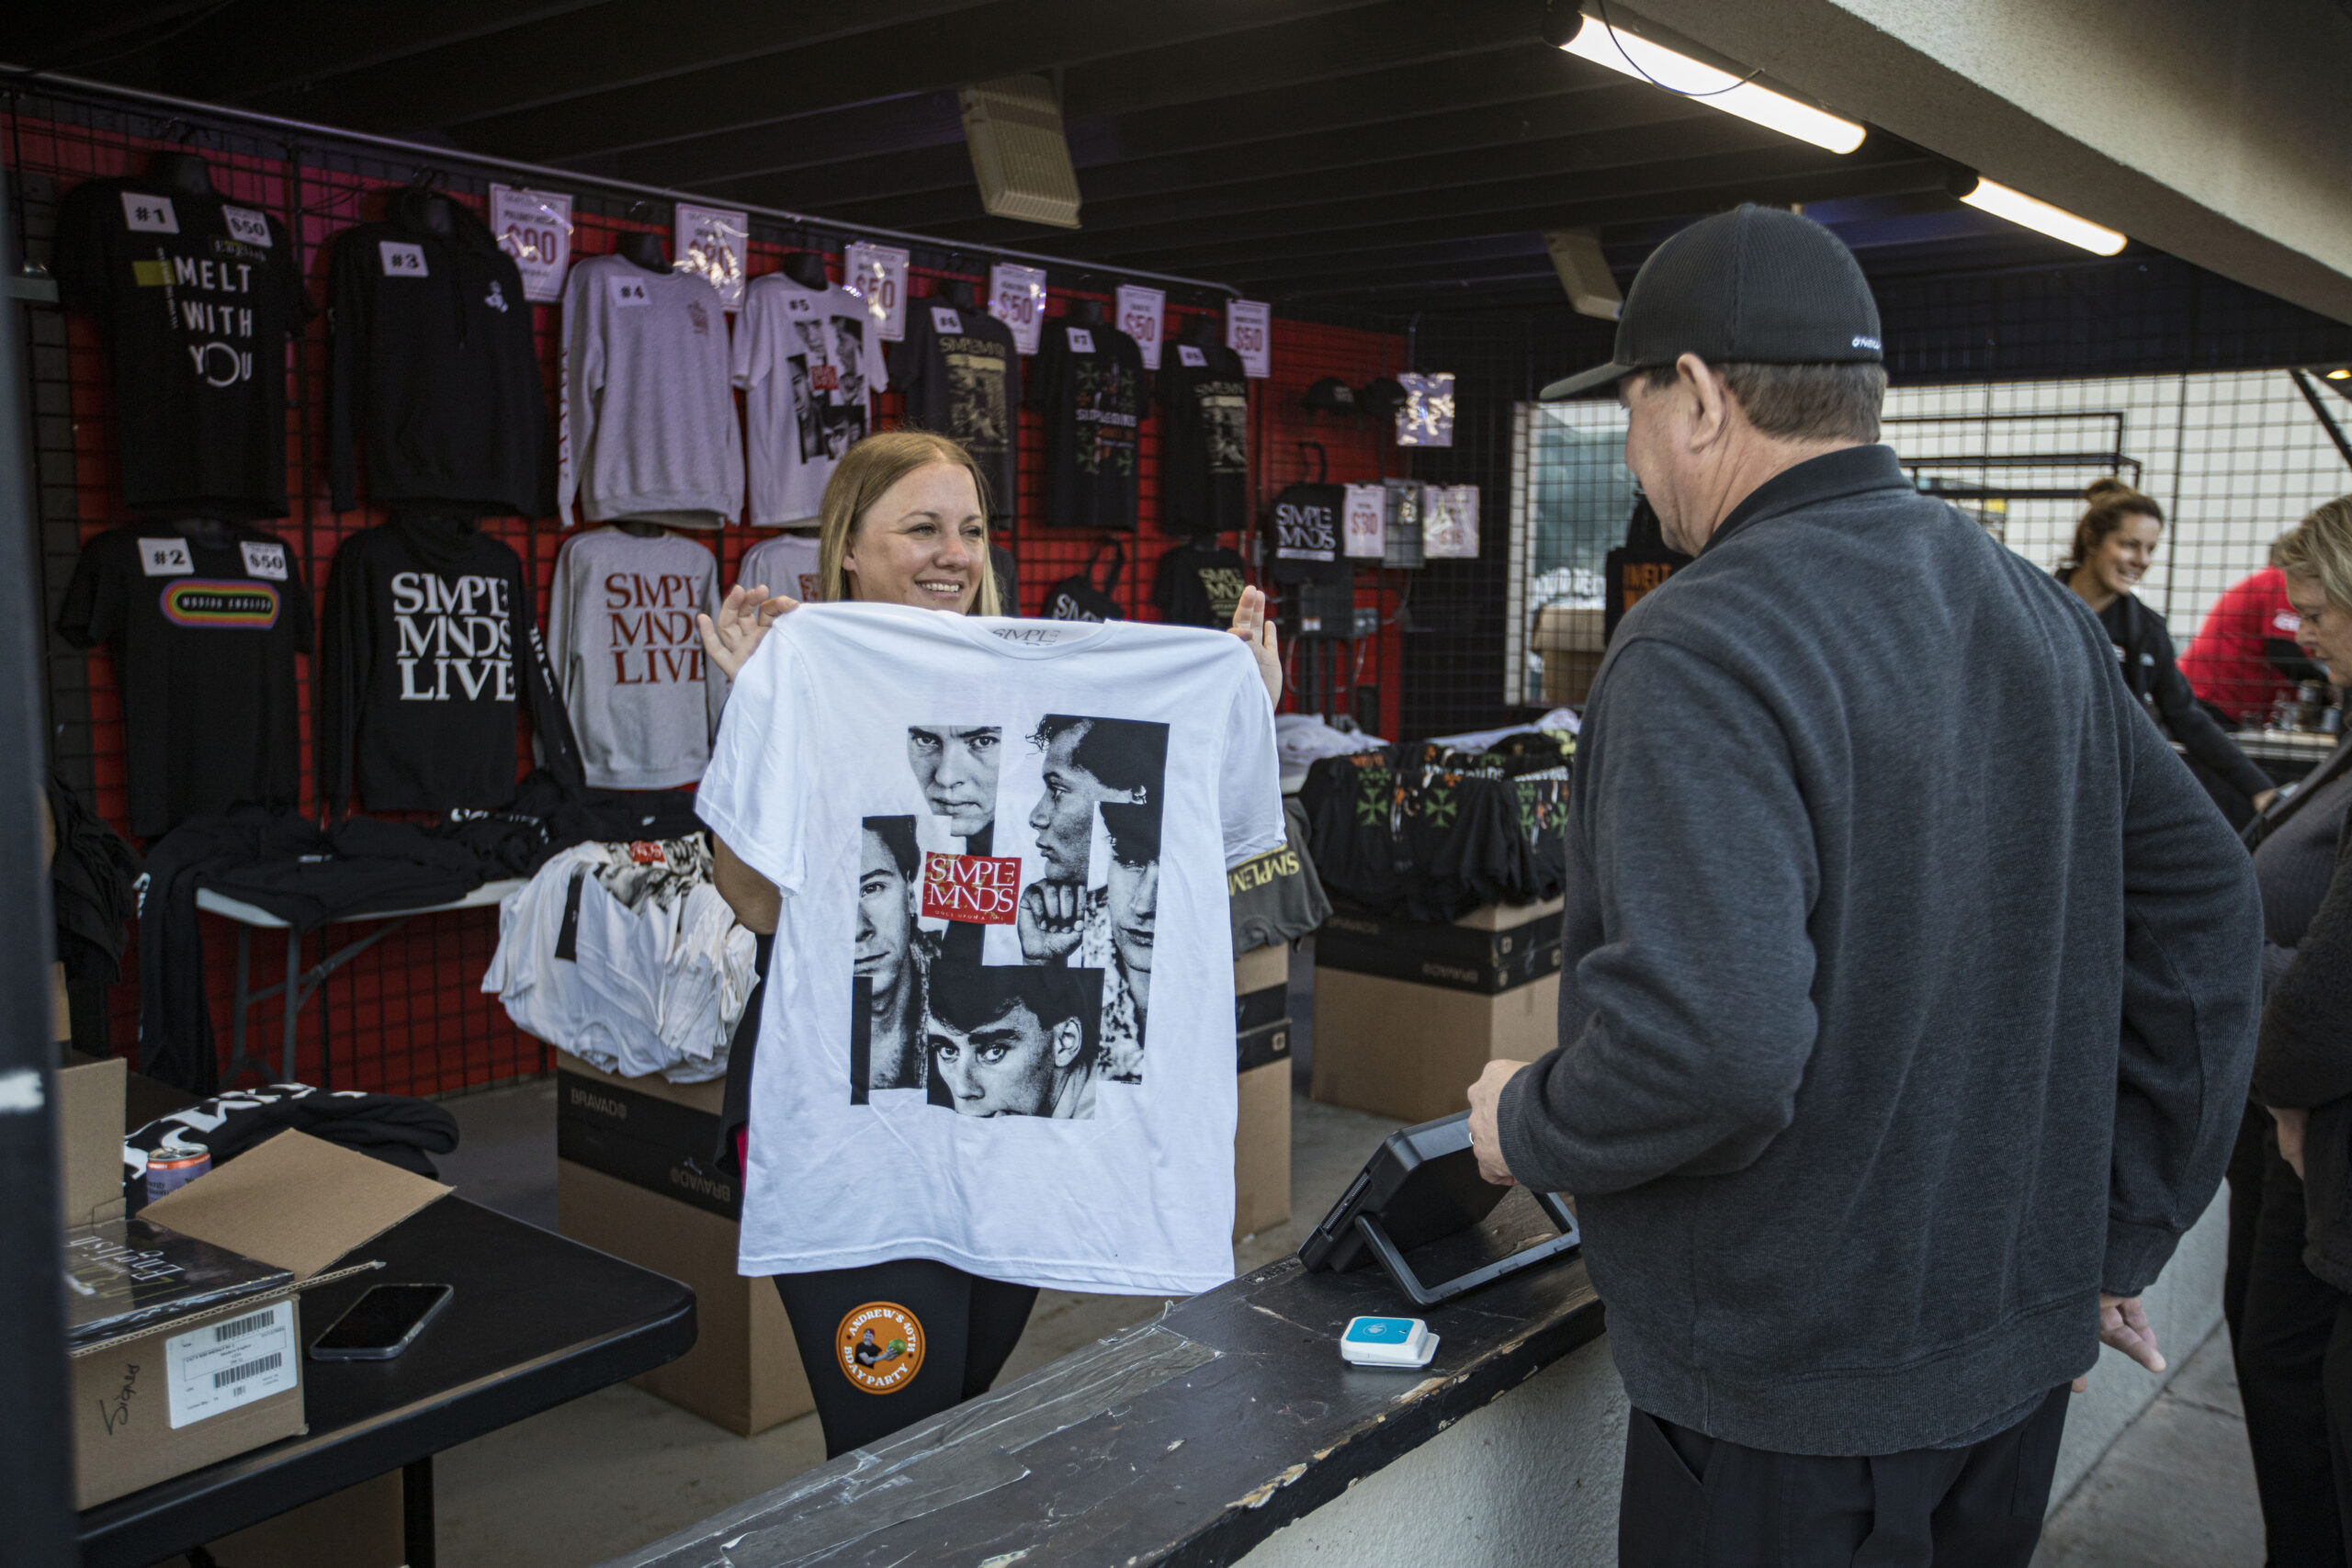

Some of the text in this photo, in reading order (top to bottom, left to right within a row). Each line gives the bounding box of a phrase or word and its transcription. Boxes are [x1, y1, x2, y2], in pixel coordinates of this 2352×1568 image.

[134, 207, 166, 224] #1
[231, 218, 266, 237] $50
[173, 254, 252, 293] MELT
[390, 253, 420, 271] #3
[621, 286, 645, 299] #4
[789, 299, 809, 312] #5
[182, 300, 253, 339] WITH
[1000, 291, 1034, 324] $50
[1125, 312, 1155, 343] $50
[1236, 326, 1262, 352] $50
[188, 341, 253, 388] YOU
[1351, 511, 1378, 536] $30
[153, 550, 187, 566] #2
[250, 553, 283, 570] $50
[396, 658, 516, 702] LIVE
[930, 857, 1016, 887] SIMPLE
[927, 883, 1014, 913] MINDS
[934, 909, 955, 919] ONCE
[848, 1308, 917, 1352] ANDREW'S 40TH
[843, 1345, 909, 1387] BDAY PARTY
